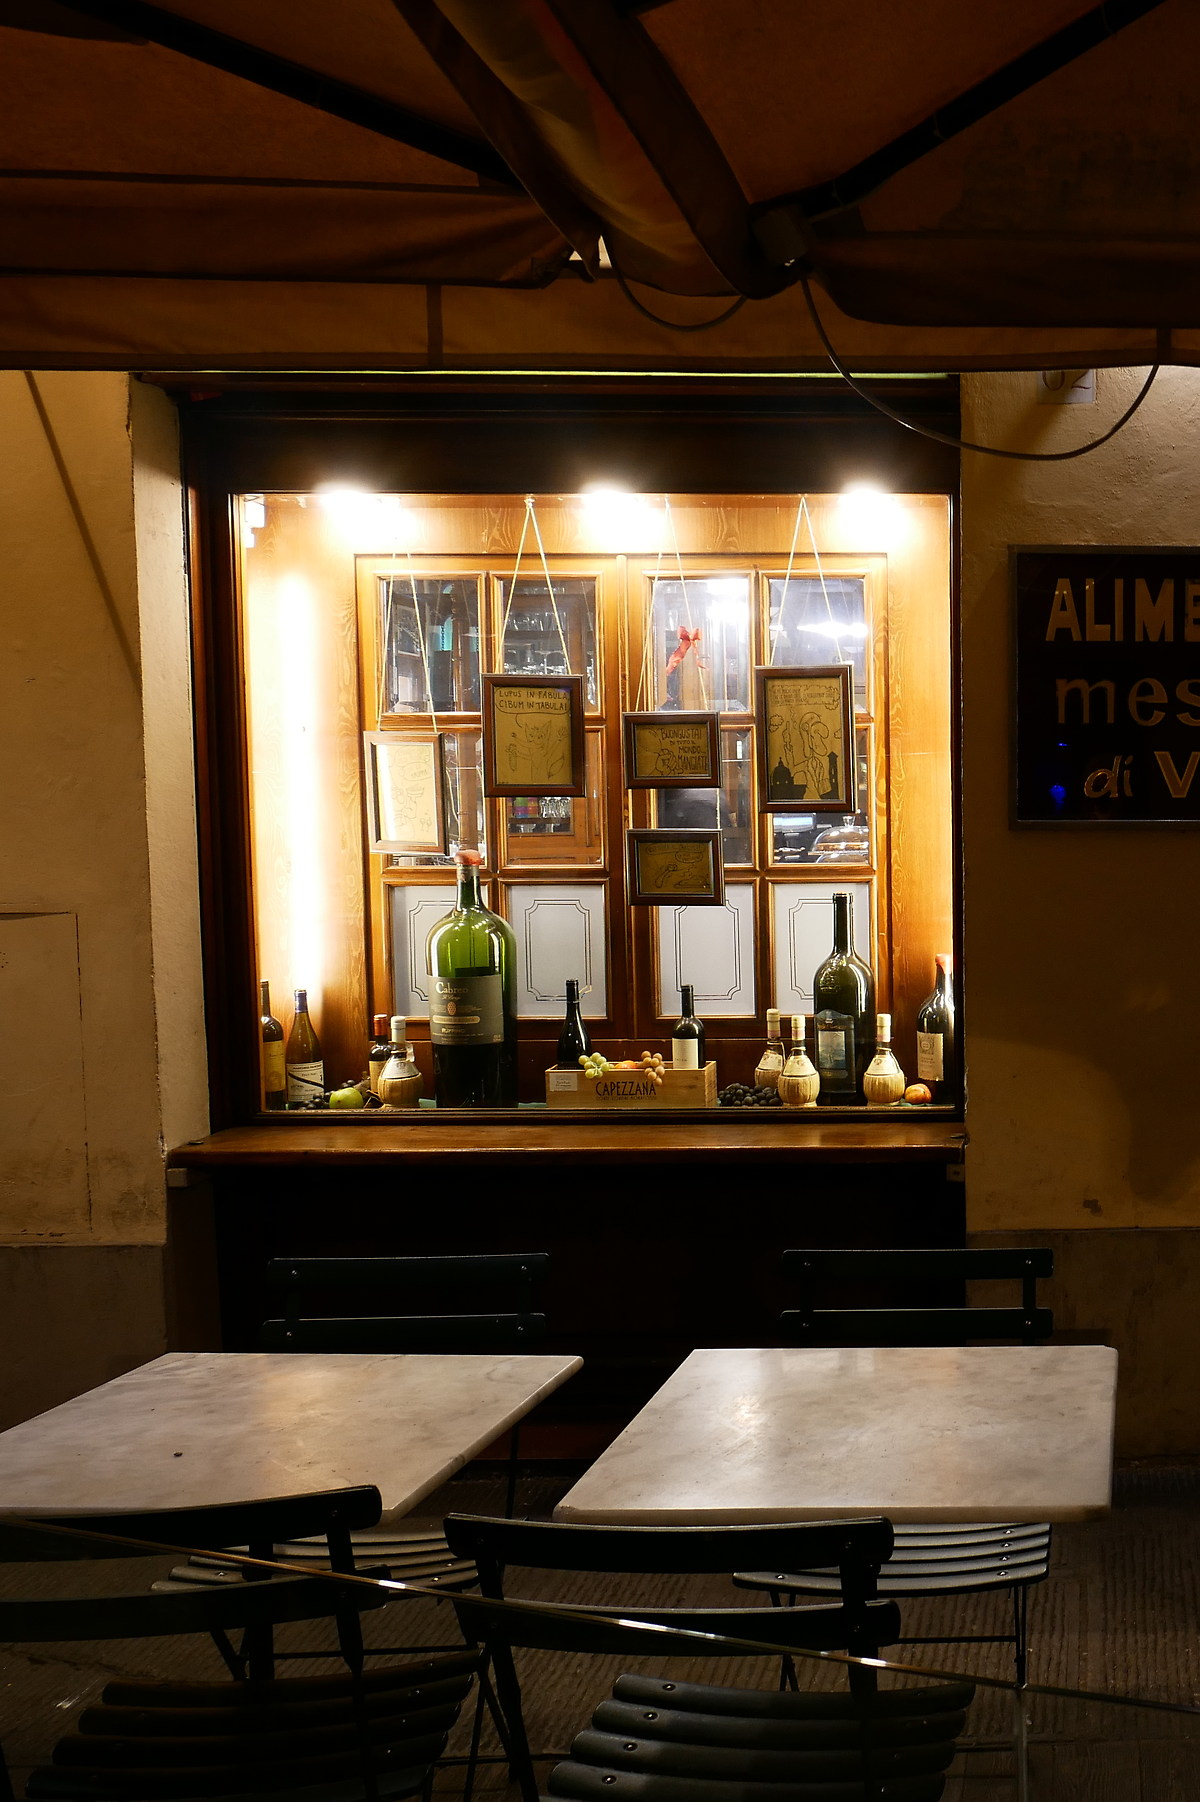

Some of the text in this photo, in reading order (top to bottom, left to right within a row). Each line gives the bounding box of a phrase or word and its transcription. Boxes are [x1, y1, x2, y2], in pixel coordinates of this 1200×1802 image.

[499, 690, 522, 698] LUPUS
[538, 690, 568, 700] FABULA
[499, 699, 524, 709] CIBUM
[527, 701, 535, 709] IN
[1084, 755, 1133, 798] di
[595, 1081, 657, 1097] CAPEZZANA
